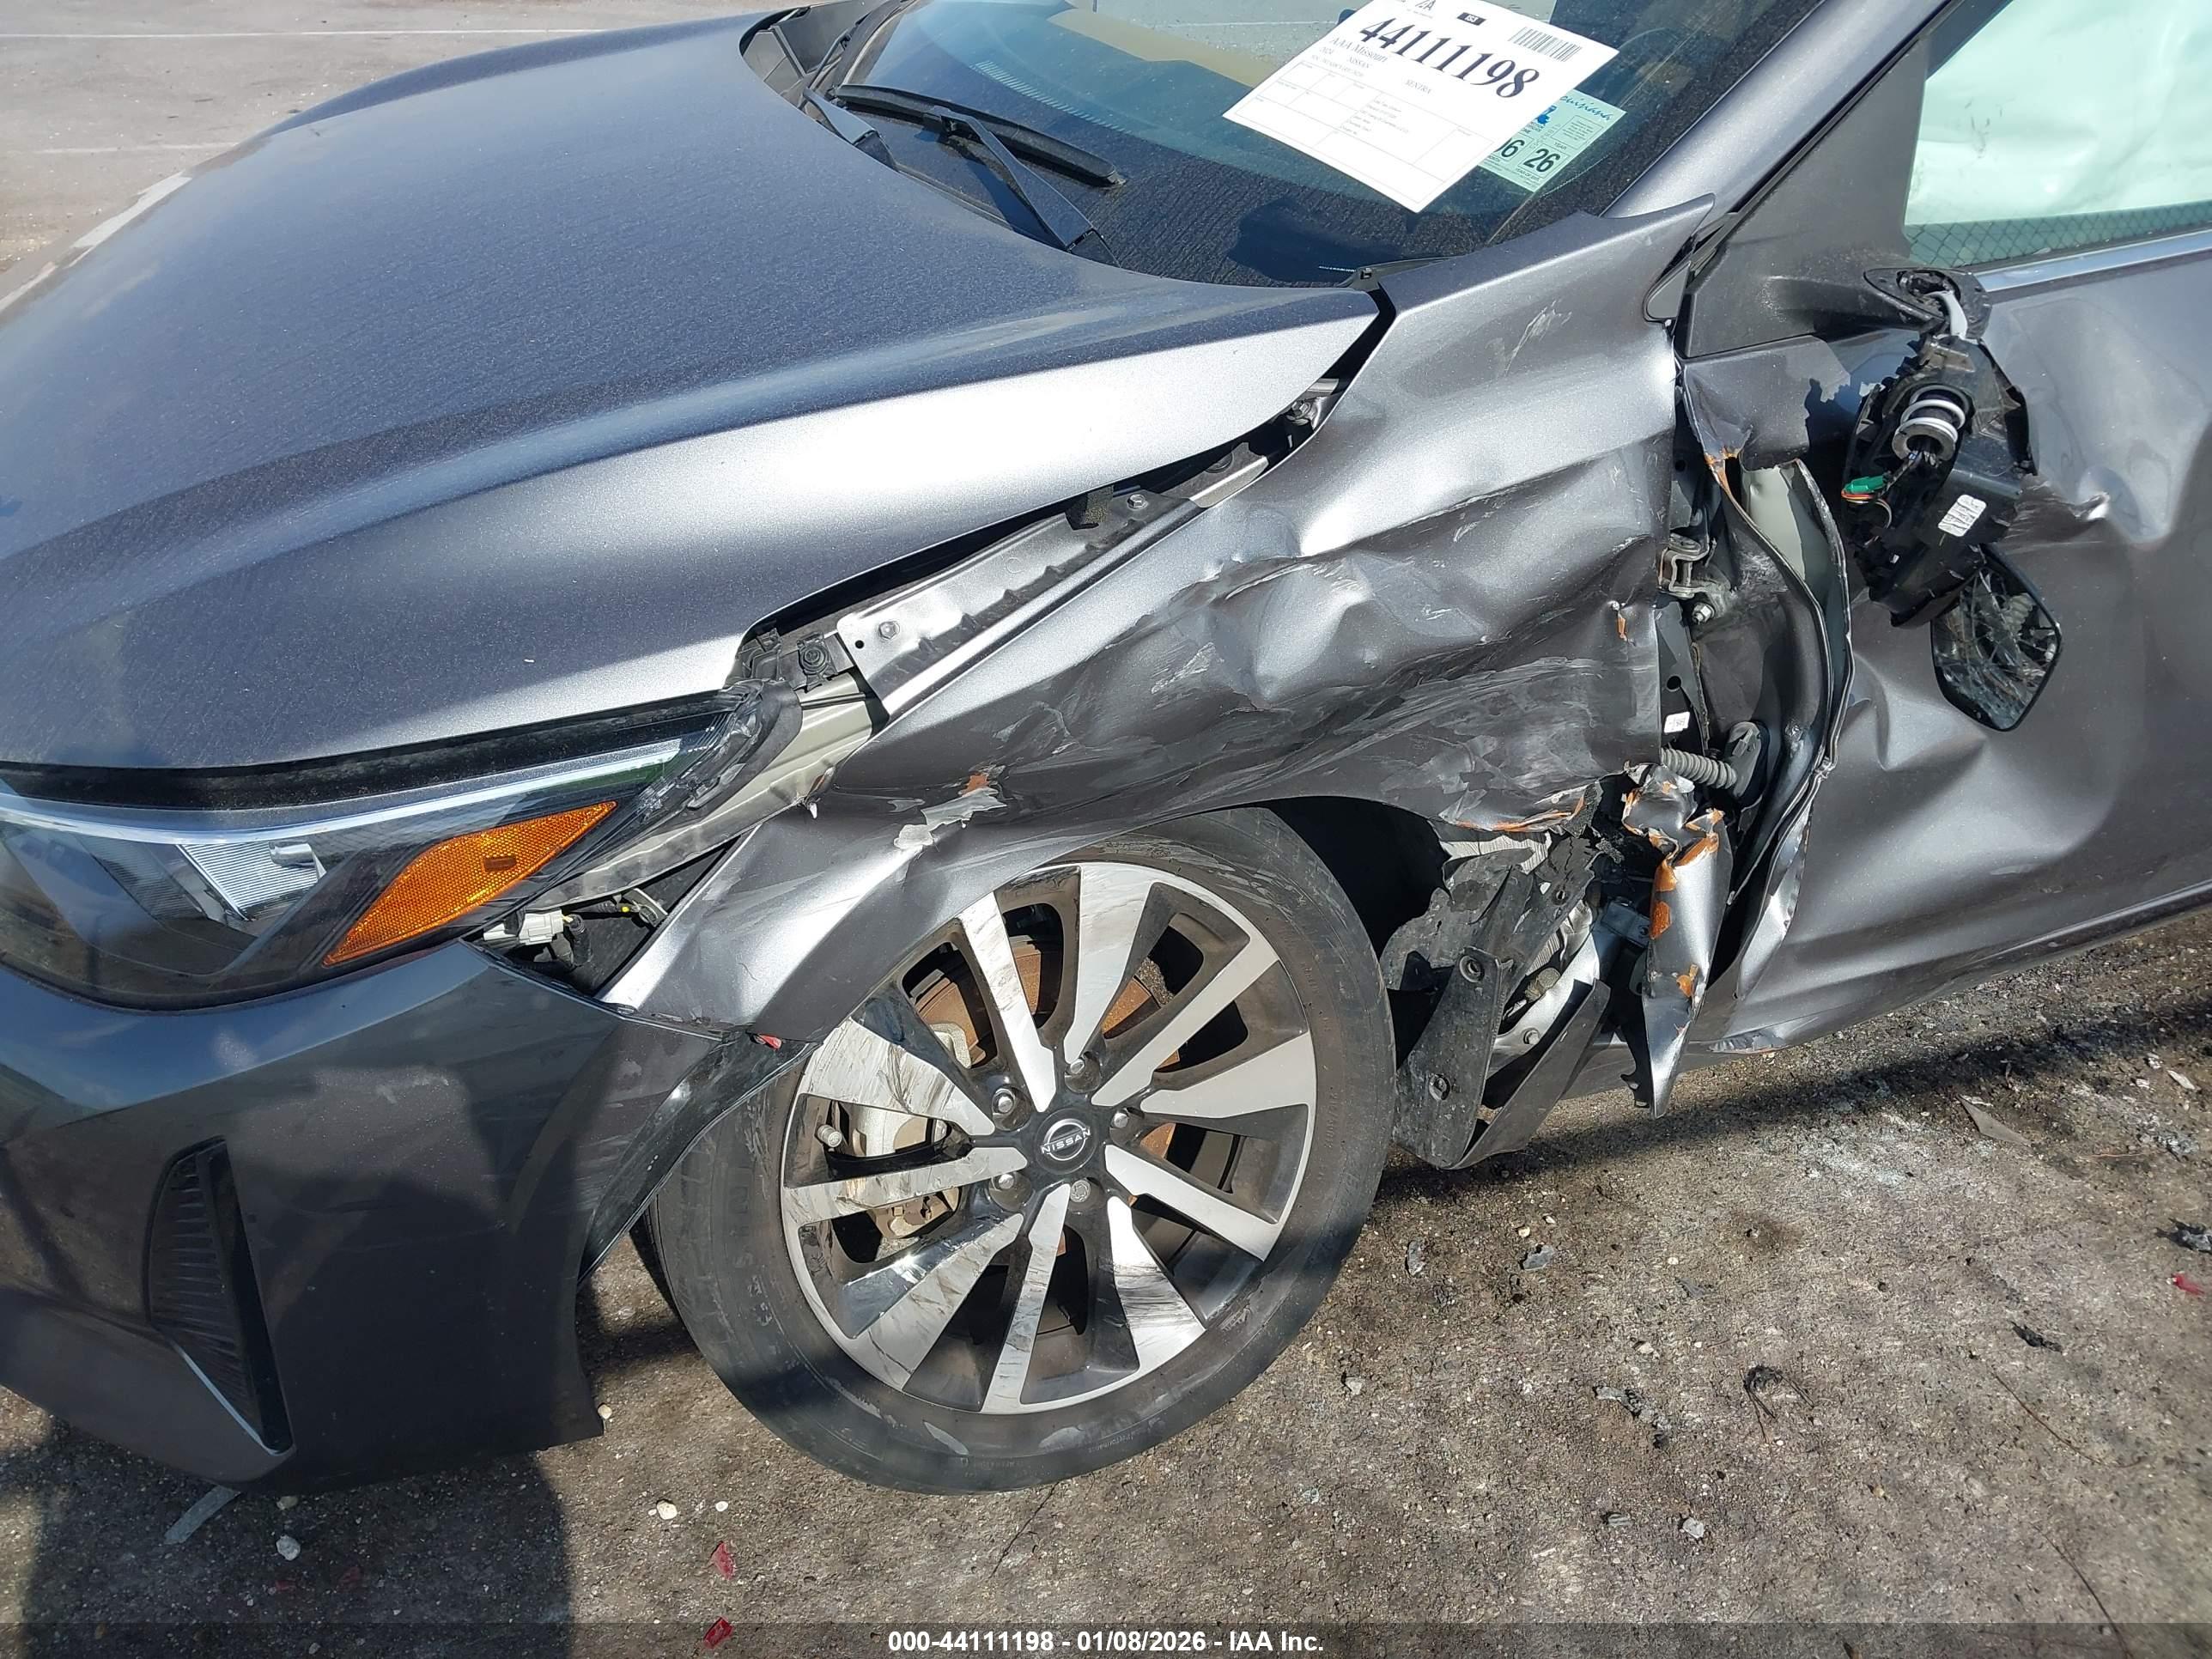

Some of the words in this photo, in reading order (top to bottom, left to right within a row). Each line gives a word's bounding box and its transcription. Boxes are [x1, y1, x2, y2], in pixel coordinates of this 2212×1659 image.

[1359, 17, 1540, 98] 44111198
[1559, 94, 1612, 121] ouisiana
[1523, 149, 1561, 173] 26
[1041, 1127, 1091, 1154] NISSAN
